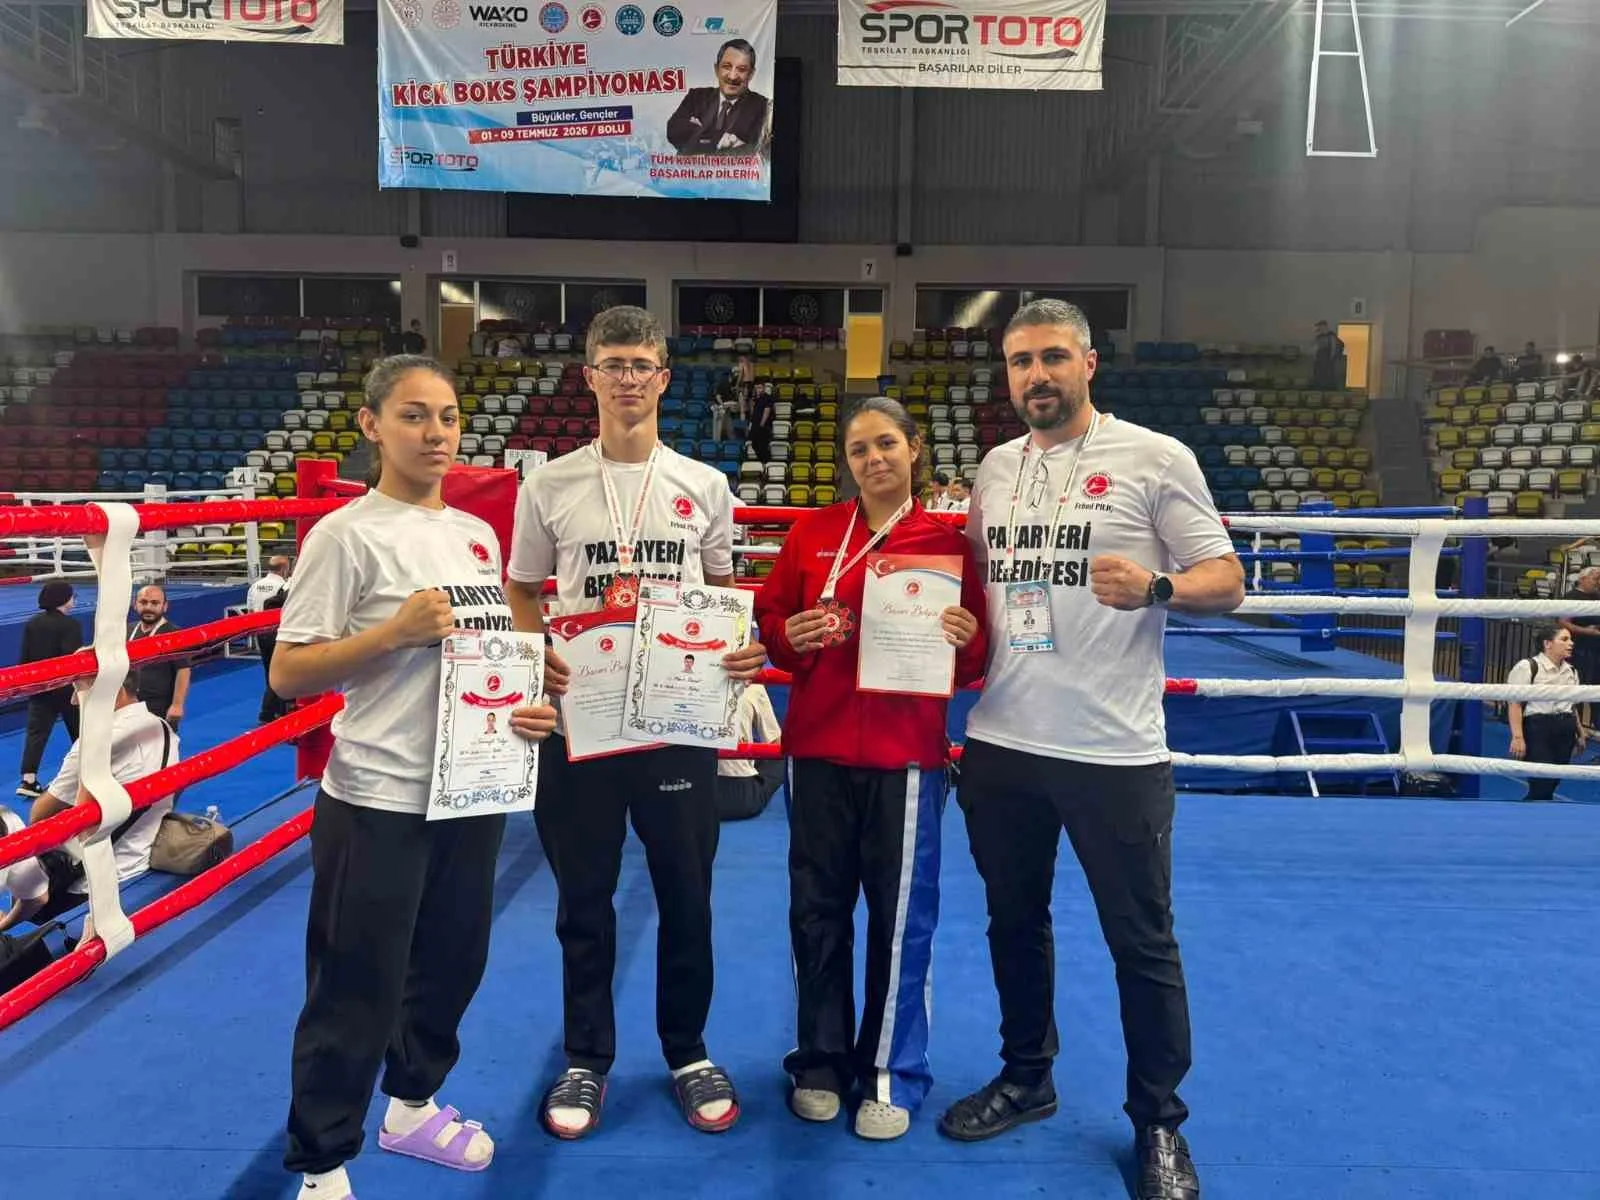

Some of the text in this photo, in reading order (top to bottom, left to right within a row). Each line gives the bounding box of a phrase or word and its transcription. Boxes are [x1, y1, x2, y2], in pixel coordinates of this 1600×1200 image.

[469, 6, 528, 22] WAKO
[484, 39, 588, 71] TÜRKİYE
[861, 47, 907, 55] TEŞKİLAT
[918, 63, 1022, 75] BAŞARILAR DİLER
[392, 68, 686, 105] KİCK BOKS ŞAMPİYONASI
[579, 109, 619, 121] Gençler
[481, 131, 492, 141] 01
[502, 130, 514, 139] 09
[516, 127, 558, 138] TEMMUZ
[564, 125, 588, 136] 2026
[597, 124, 625, 134] BOLU
[866, 263, 873, 276] 7
